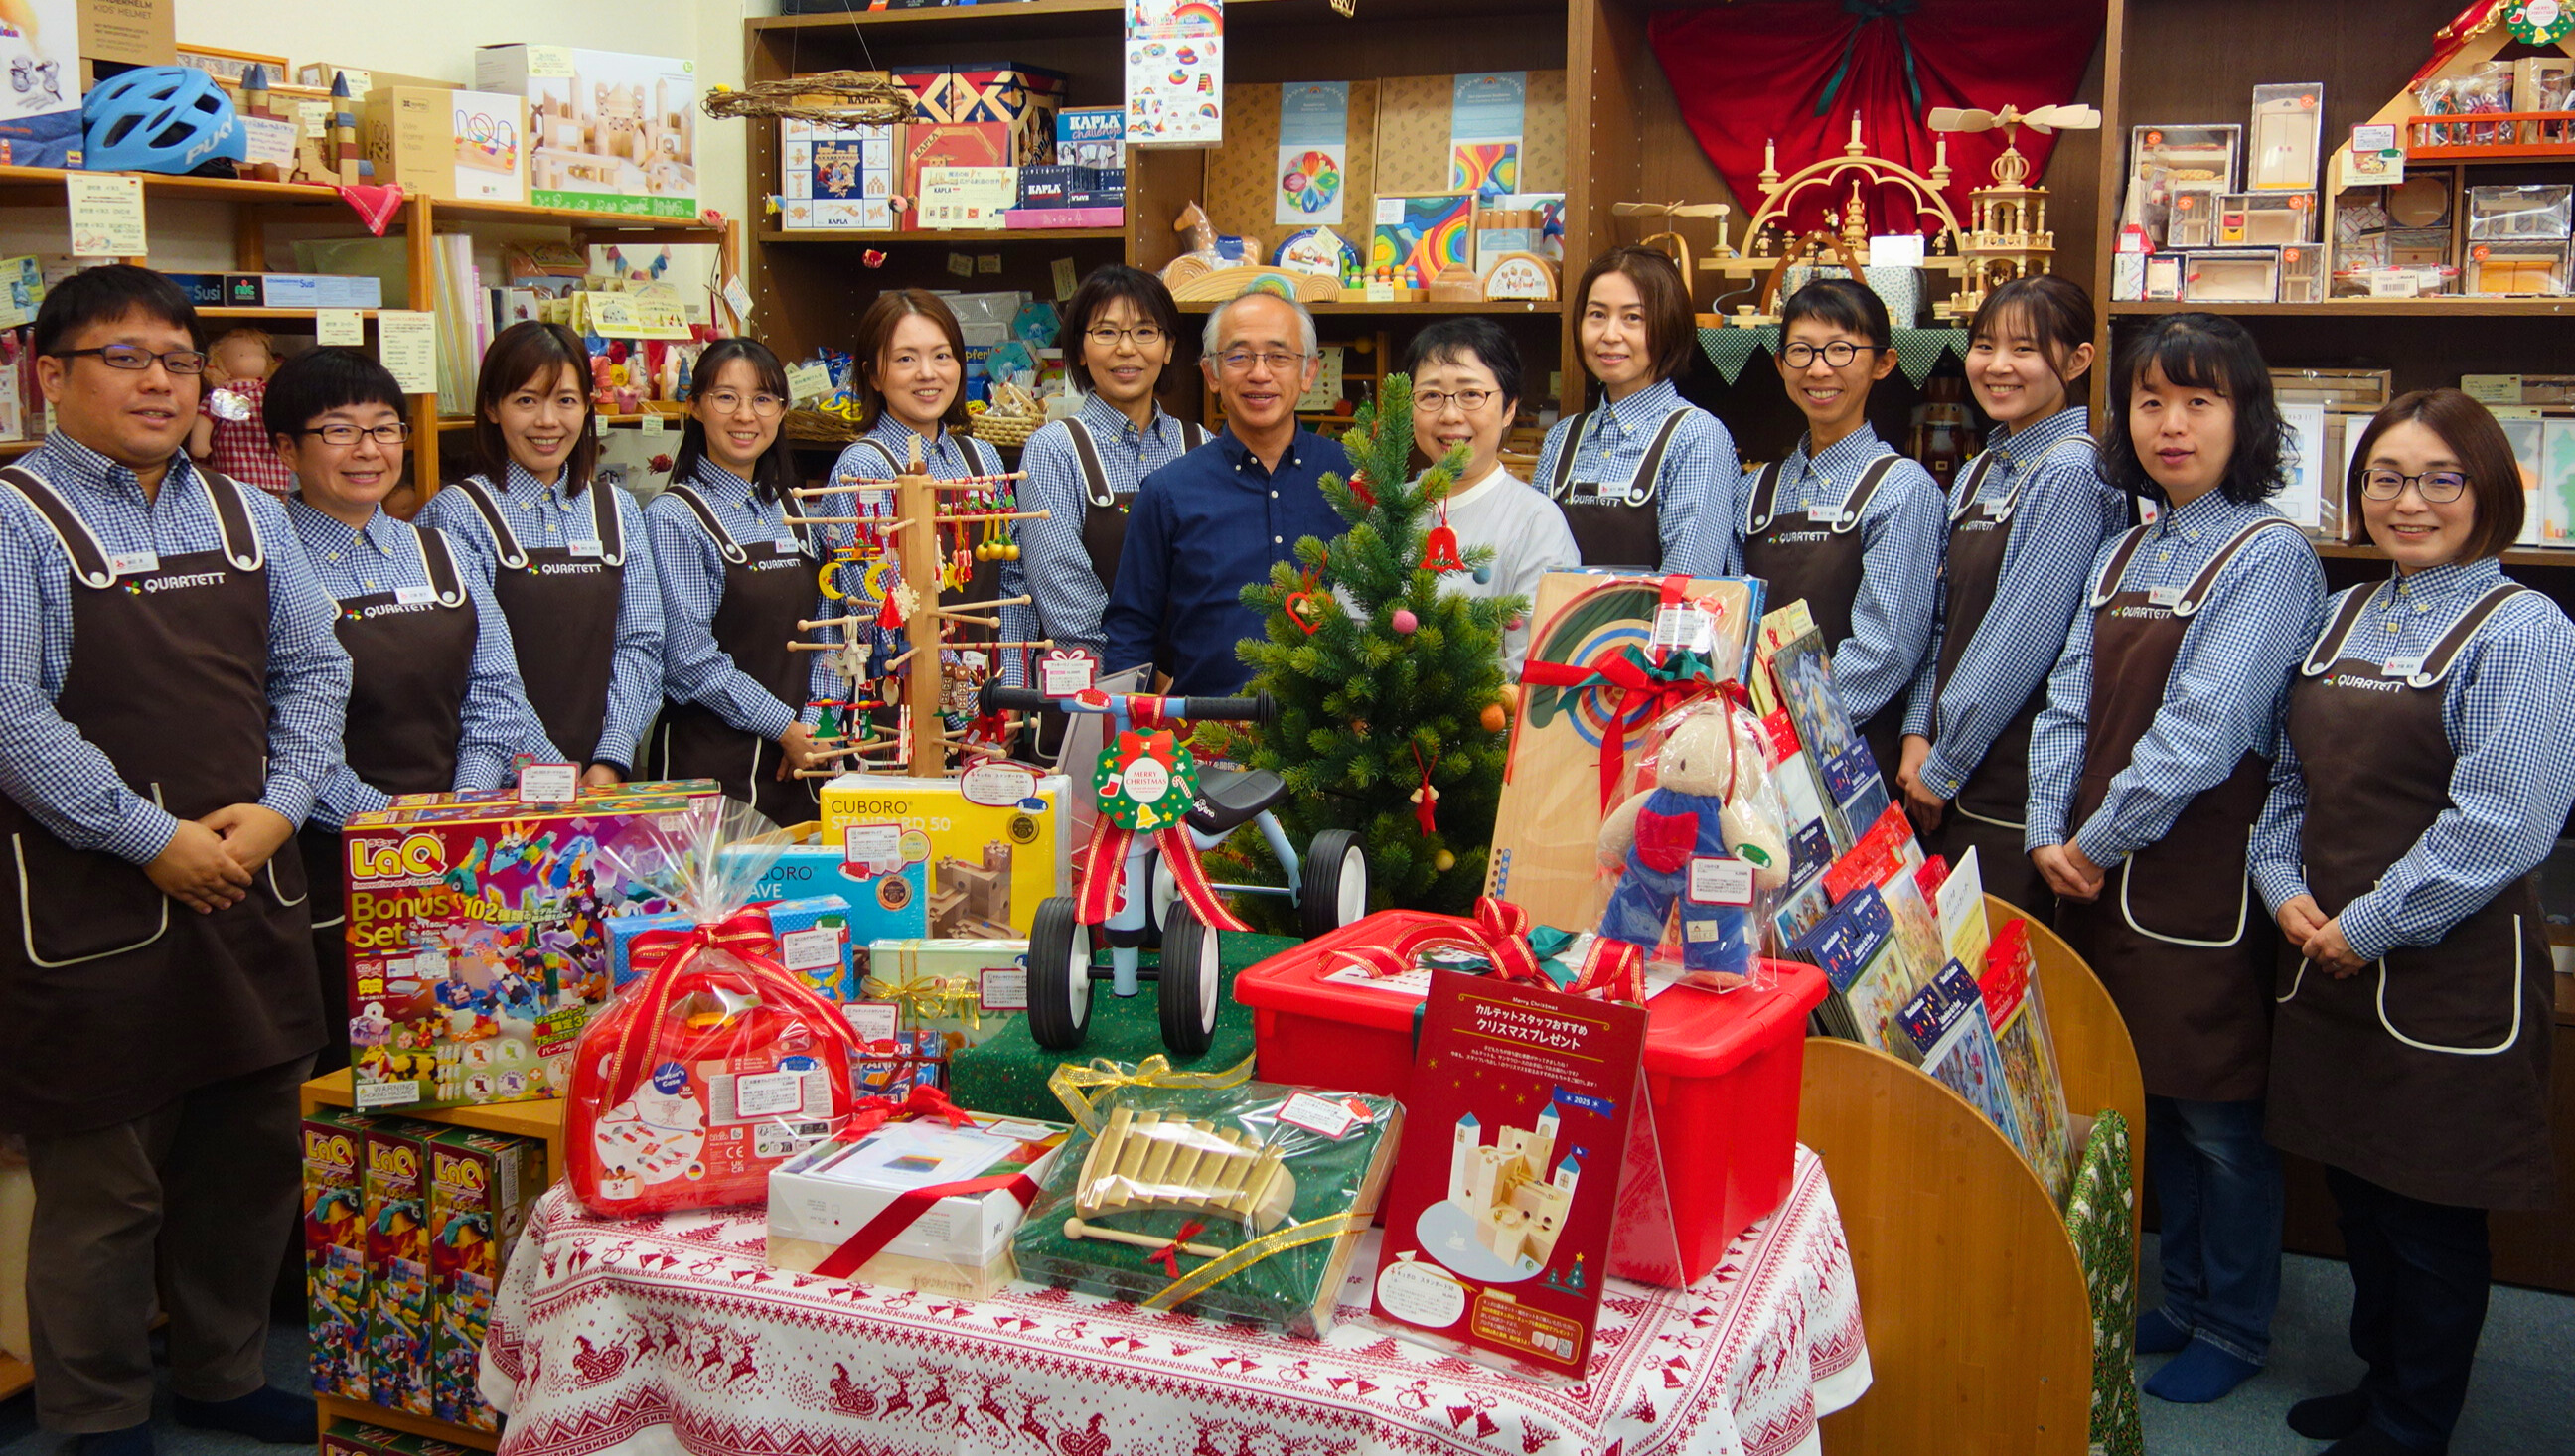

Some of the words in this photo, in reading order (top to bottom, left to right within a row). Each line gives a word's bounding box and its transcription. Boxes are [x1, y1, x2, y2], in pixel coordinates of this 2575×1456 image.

[119, 7, 152, 19] HELMET
[847, 95, 881, 105] KAPLA
[1070, 115, 1121, 130] KAPLA
[185, 113, 233, 165] PUKY
[1072, 126, 1122, 139] challenge
[913, 132, 939, 158] KAPLA
[1028, 184, 1062, 195] KAPLA
[194, 284, 221, 301] Susi
[1573, 494, 1621, 508] QUARTETT
[1779, 531, 1830, 544] QUARTETT
[541, 563, 602, 575] QUARTETT
[758, 558, 801, 571] QUARTETT
[144, 571, 226, 594] QUARTETT
[364, 602, 435, 619] QUARTETT
[2121, 606, 2174, 620] QUARTETT
[2337, 674, 2405, 693] QUARTETT
[831, 800, 908, 814] CUBORO
[930, 816, 951, 832] 50
[350, 833, 448, 880] LaQ
[353, 880, 393, 890] Innovative
[410, 877, 443, 886] Creative
[351, 892, 451, 922] Bonus
[354, 921, 408, 948] Set
[1512, 996, 1530, 1006] Merry
[1530, 999, 1559, 1011] Christmas
[1475, 1003, 1589, 1036] カルテットスタッフおすすめ
[1476, 1018, 1581, 1050] クリスマスプレゼント
[655, 1069, 685, 1083] Doctor's
[662, 1079, 681, 1088] Case
[374, 1083, 415, 1093] WARNING
[1574, 1095, 1590, 1106] 2025
[305, 1129, 355, 1168] LaQ
[368, 1140, 418, 1179] LaQ
[434, 1151, 486, 1193] LaQ
[611, 1182, 624, 1191] 3+
